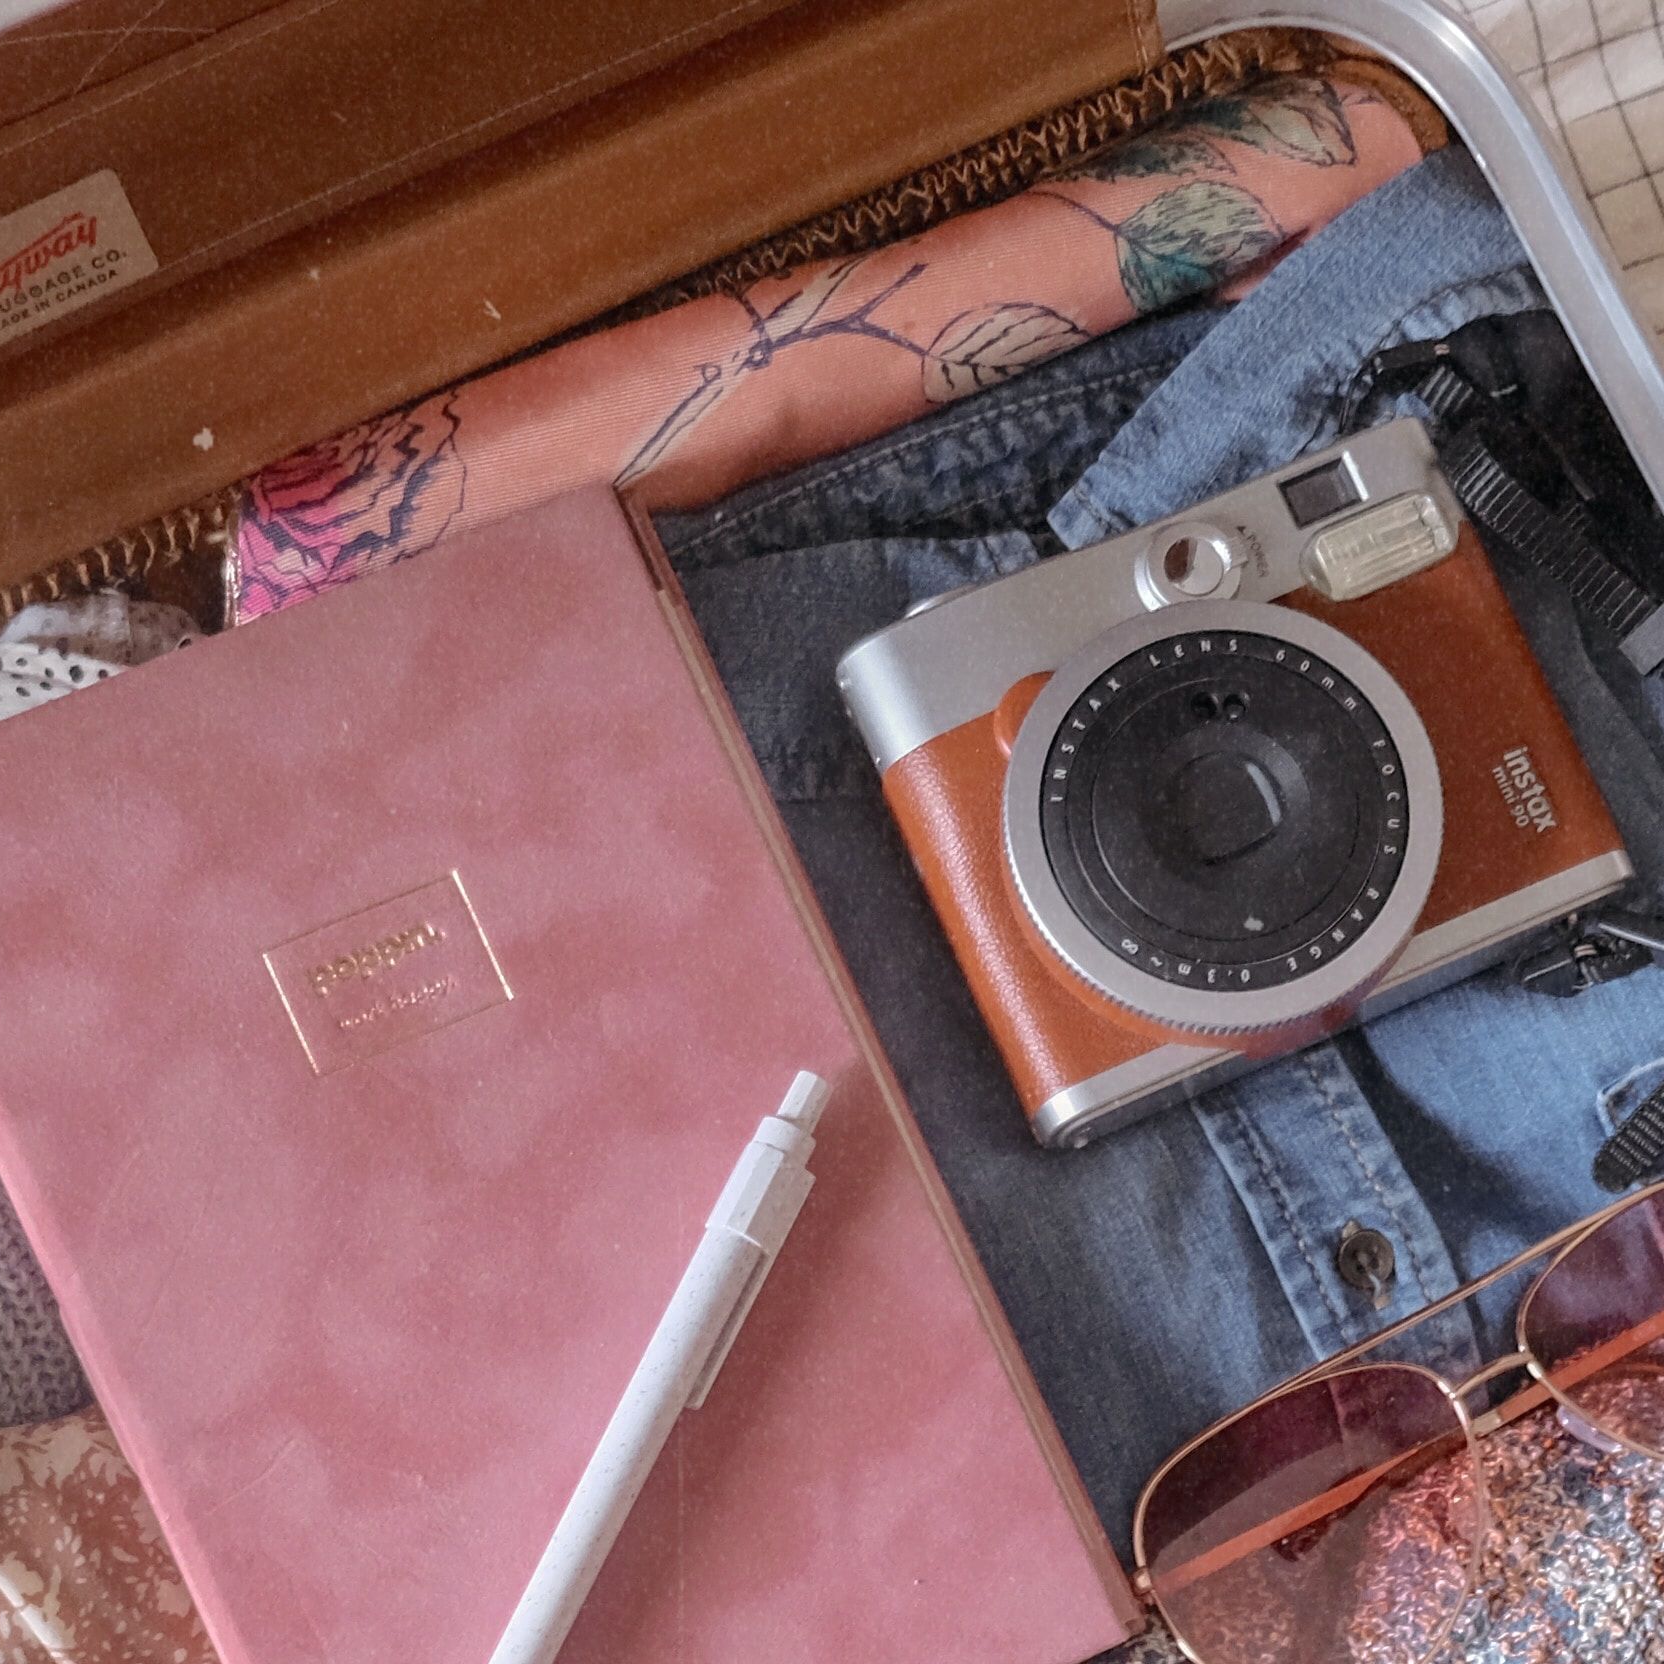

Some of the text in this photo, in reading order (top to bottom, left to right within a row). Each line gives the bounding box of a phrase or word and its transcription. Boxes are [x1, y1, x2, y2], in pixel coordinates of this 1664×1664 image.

[91, 249, 127, 269] CO.
[34, 299, 51, 313] IN
[55, 268, 119, 303] CANADA
[1148, 638, 1238, 667] LENS
[1274, 649, 1357, 711] 60mm
[1050, 677, 1122, 802] INSTAX
[1372, 739, 1401, 855] FOCUS
[1492, 766, 1530, 828] mini 90
[1503, 746, 1557, 833] instax
[1286, 887, 1380, 973] RANGE
